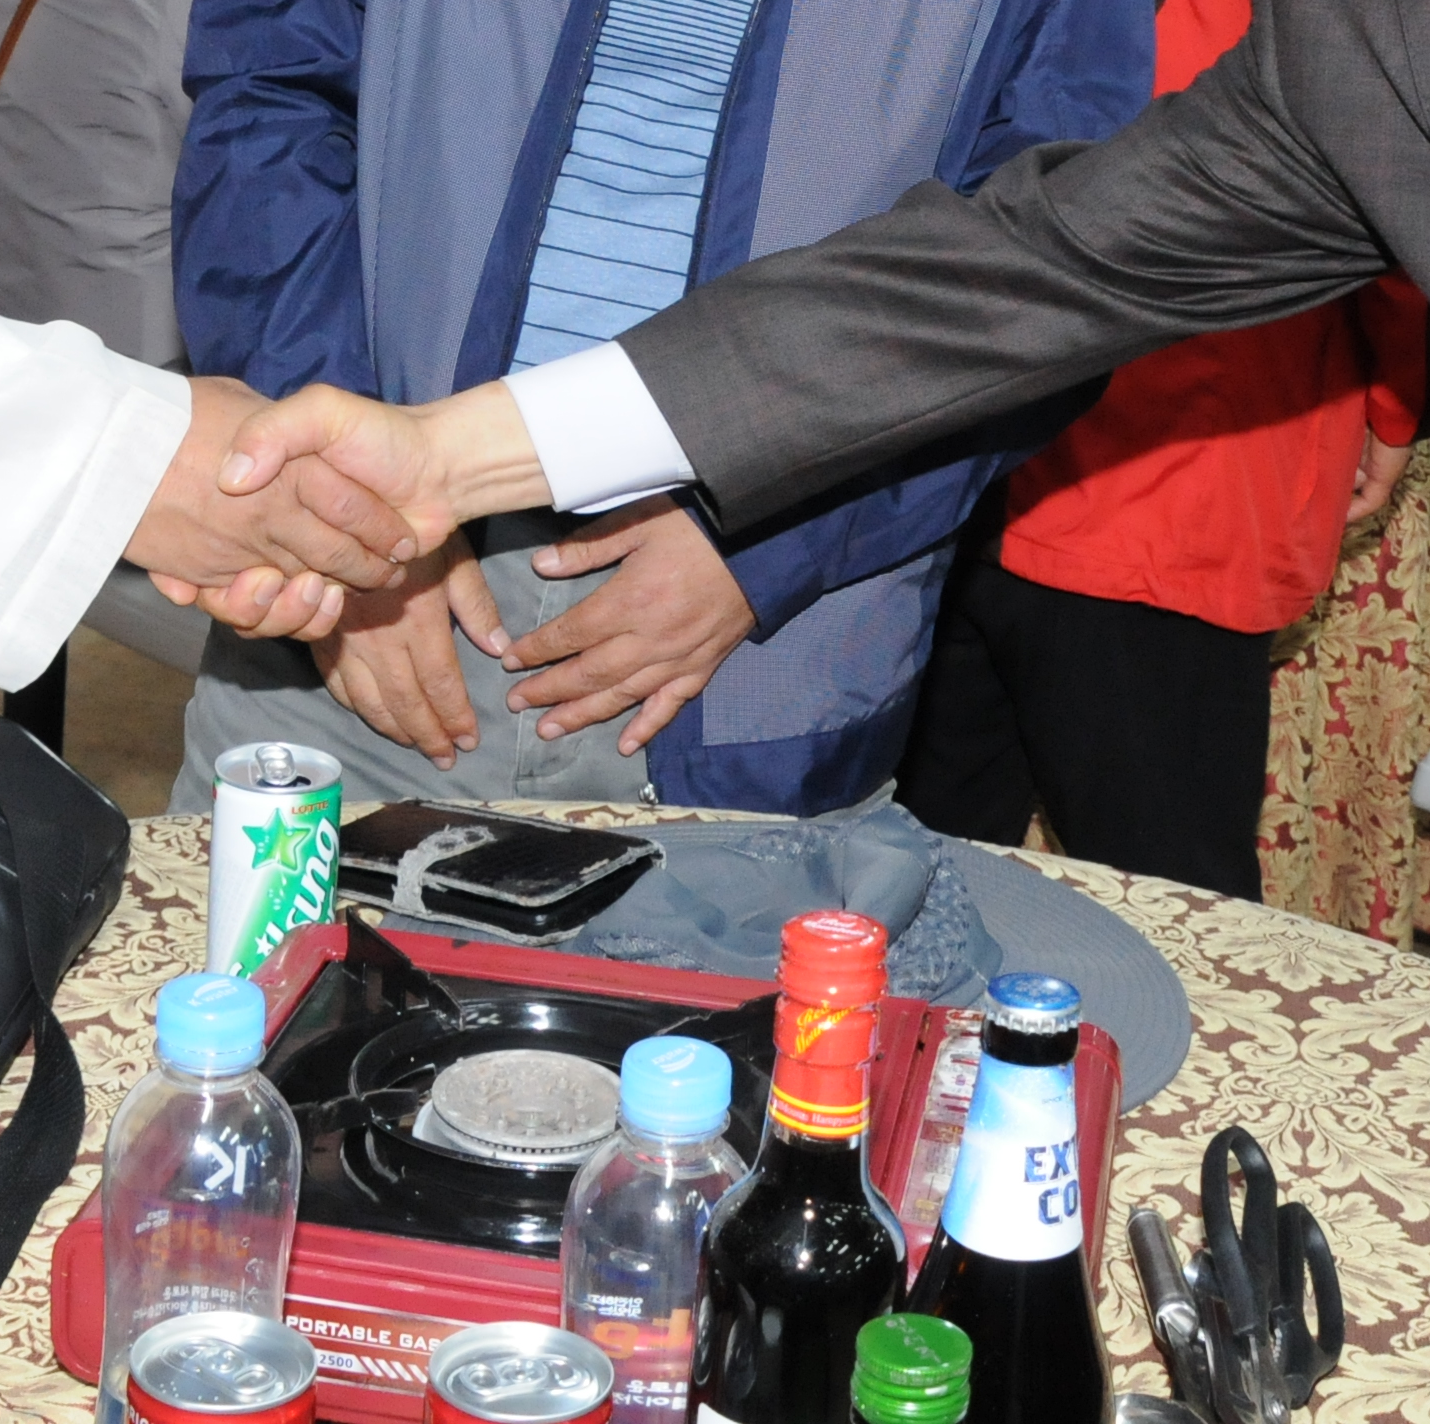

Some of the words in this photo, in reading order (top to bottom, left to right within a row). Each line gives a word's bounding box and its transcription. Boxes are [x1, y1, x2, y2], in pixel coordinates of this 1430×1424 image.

[291, 800, 329, 815] LOTTE
[286, 1315, 391, 1345] PORTABLE
[319, 1353, 353, 1369] 2500
